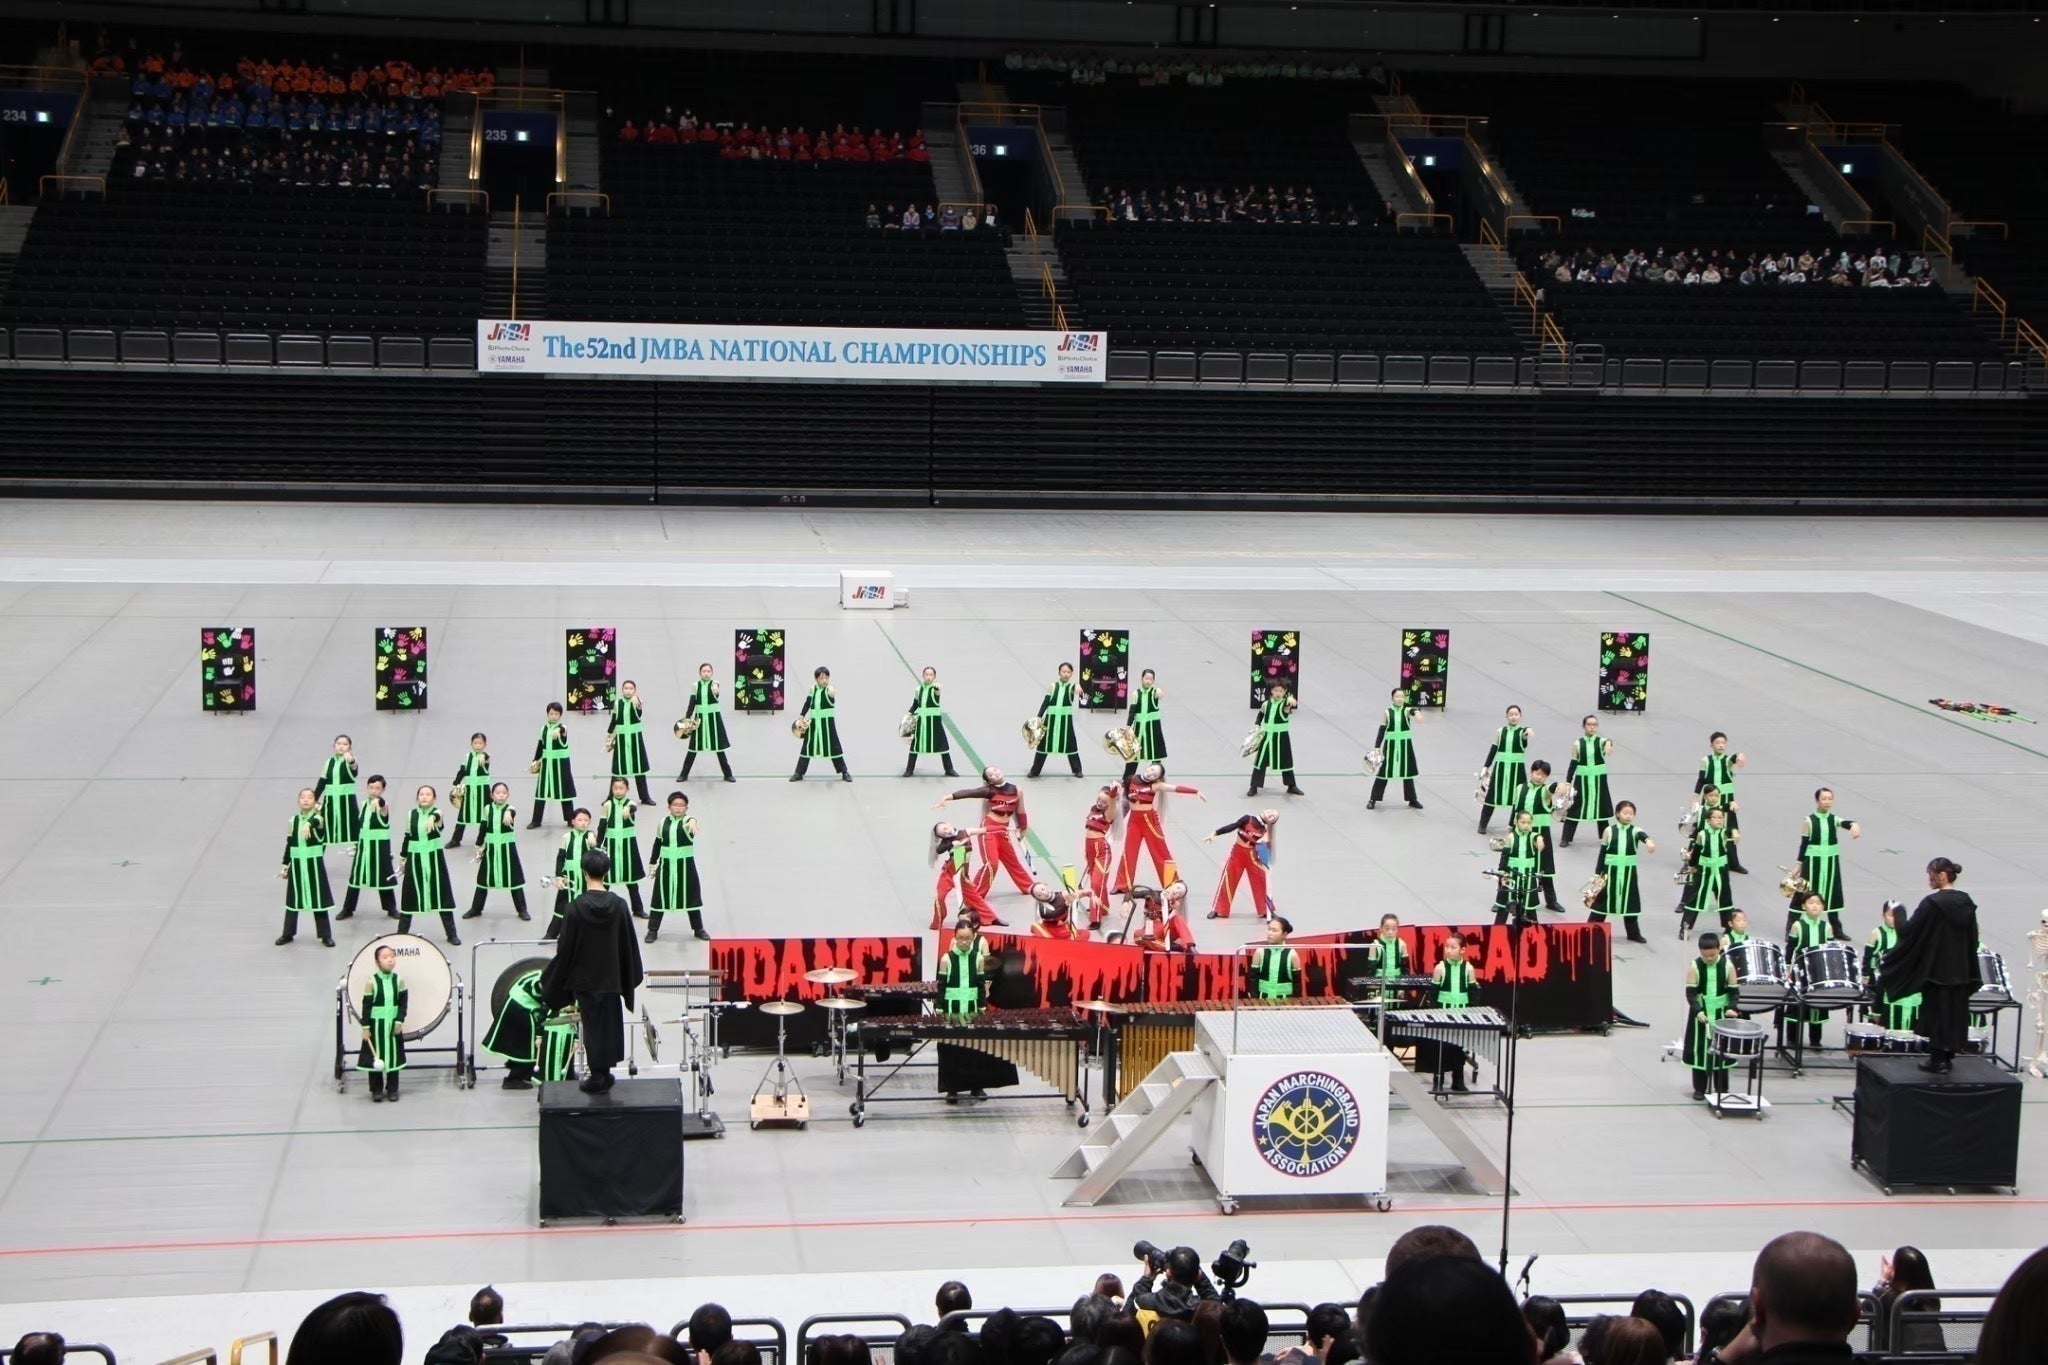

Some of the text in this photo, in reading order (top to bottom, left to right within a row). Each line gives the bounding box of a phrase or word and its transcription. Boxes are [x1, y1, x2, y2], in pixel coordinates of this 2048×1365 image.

[3, 110, 27, 121] 234
[485, 130, 507, 141] 235
[640, 337, 704, 363] JMBA
[709, 339, 836, 363] NATIONAL
[843, 341, 1046, 366] CHAMPIONSHIPS
[742, 938, 917, 1000] DANCE
[1150, 953, 1187, 1002] OF
[1255, 1073, 1359, 1130] JAPAN MARCHINGBAND
[1264, 1146, 1347, 1175] ASSOCIATION
